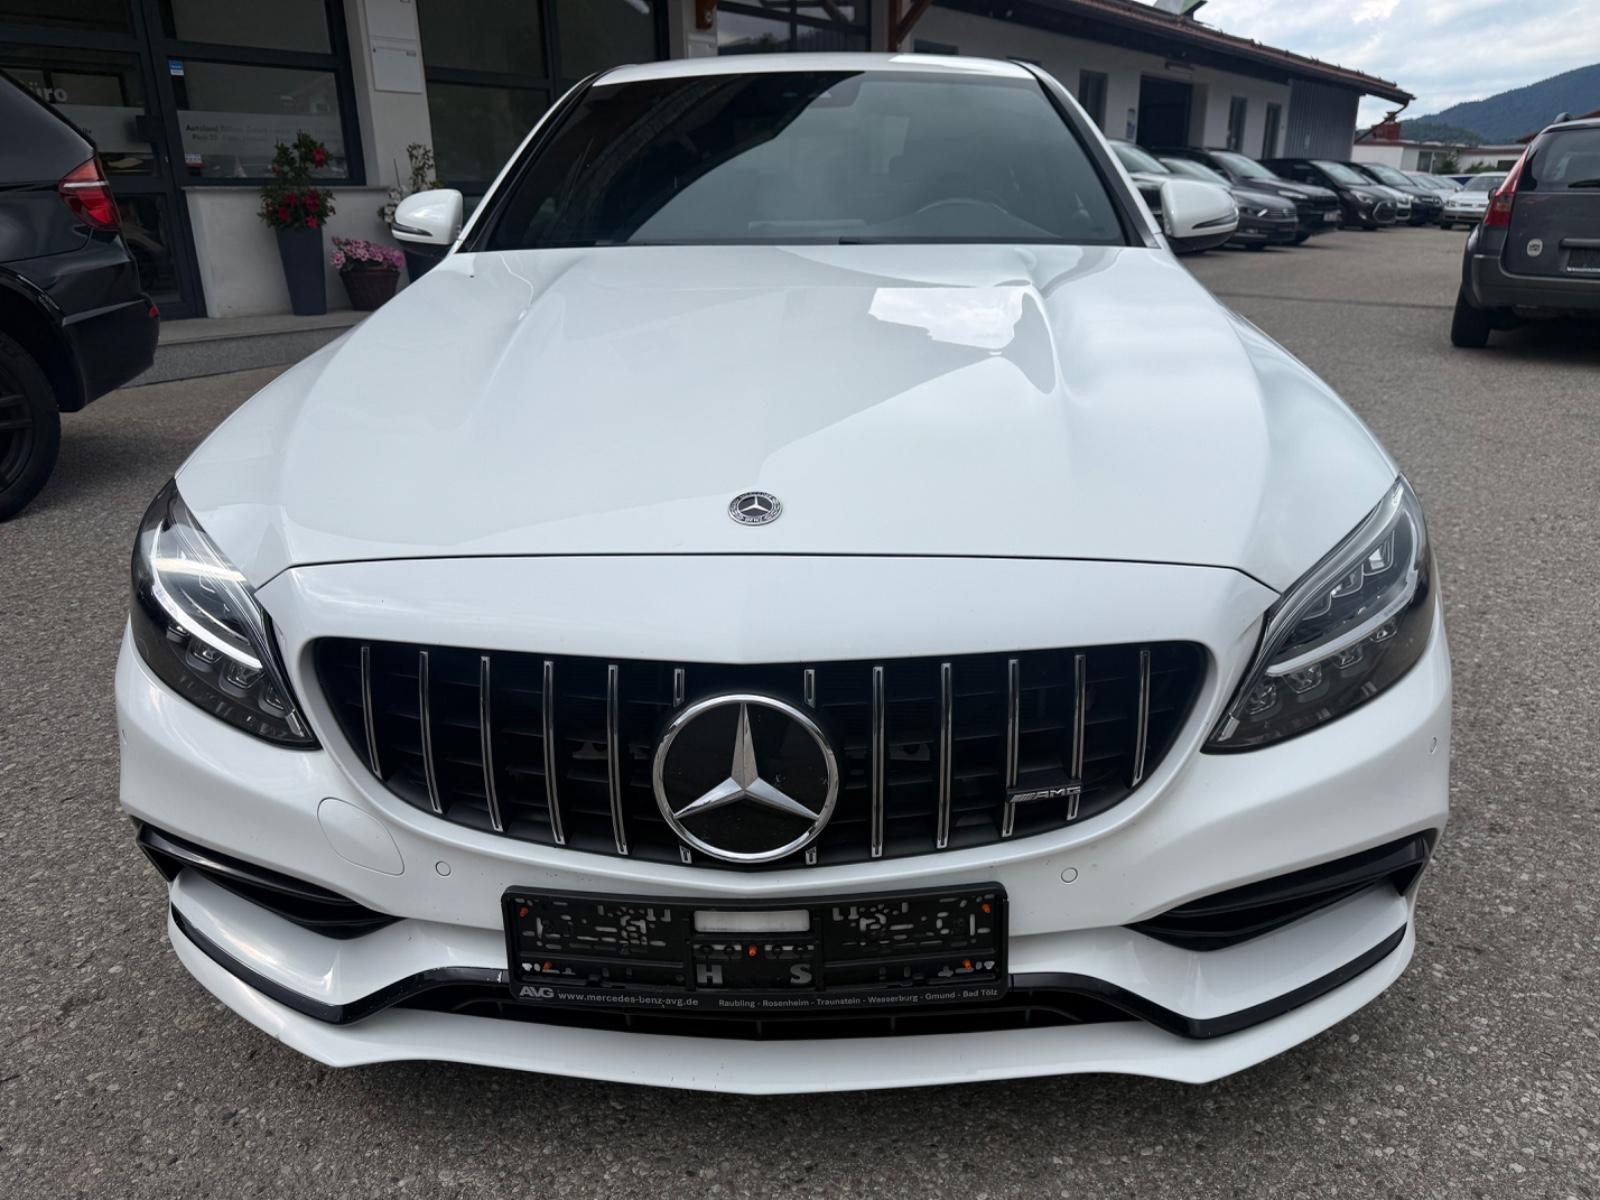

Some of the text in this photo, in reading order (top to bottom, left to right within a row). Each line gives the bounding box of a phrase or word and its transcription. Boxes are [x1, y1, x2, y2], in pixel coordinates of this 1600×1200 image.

[28, 81, 68, 102] üro
[696, 963, 723, 985] H
[789, 962, 812, 985] S
[519, 986, 699, 1007] AVG www.mercedes-benz-avg.de
[718, 998, 756, 1008] Raubling
[762, 998, 810, 1008] Rosenheim
[815, 997, 861, 1006] Traunstein
[867, 994, 919, 1004] Wasserburg
[925, 991, 956, 1001] Gmund
[962, 989, 979, 998] Bad
[981, 988, 999, 997] Tölz
